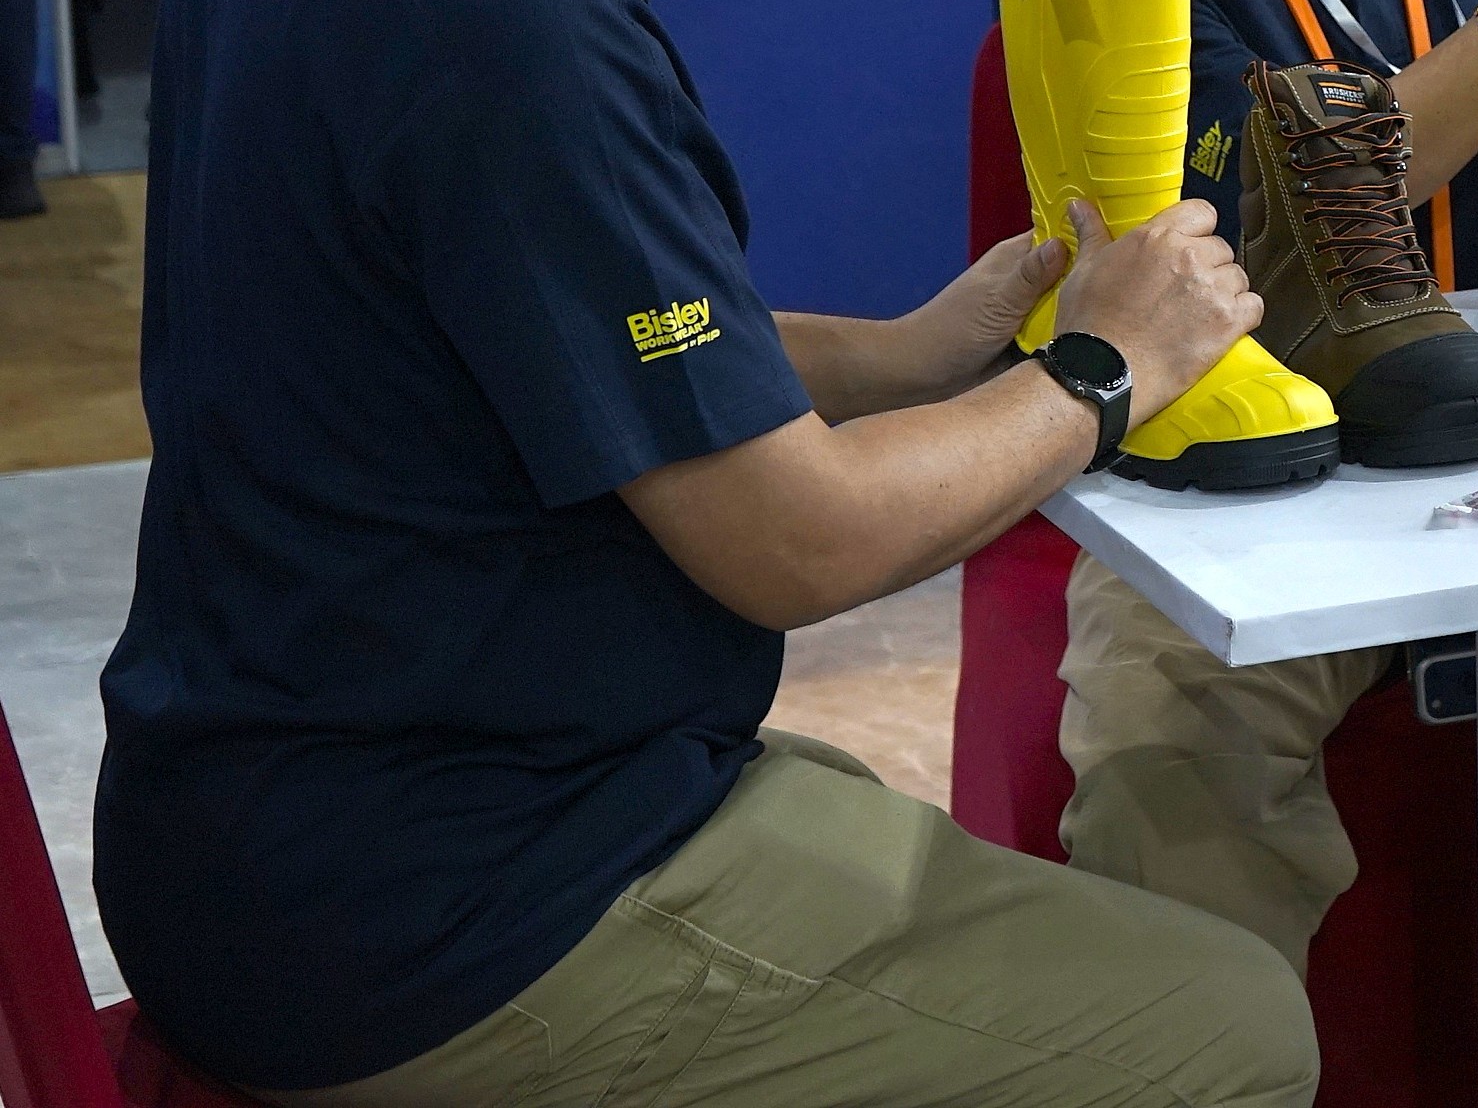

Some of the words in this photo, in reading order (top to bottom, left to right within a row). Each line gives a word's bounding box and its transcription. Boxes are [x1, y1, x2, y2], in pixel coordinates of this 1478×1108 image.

[1188, 119, 1222, 174] Bisley
[626, 297, 710, 342] Bisley
[634, 322, 704, 353] WORKWEAR
[697, 328, 721, 346] PIP
